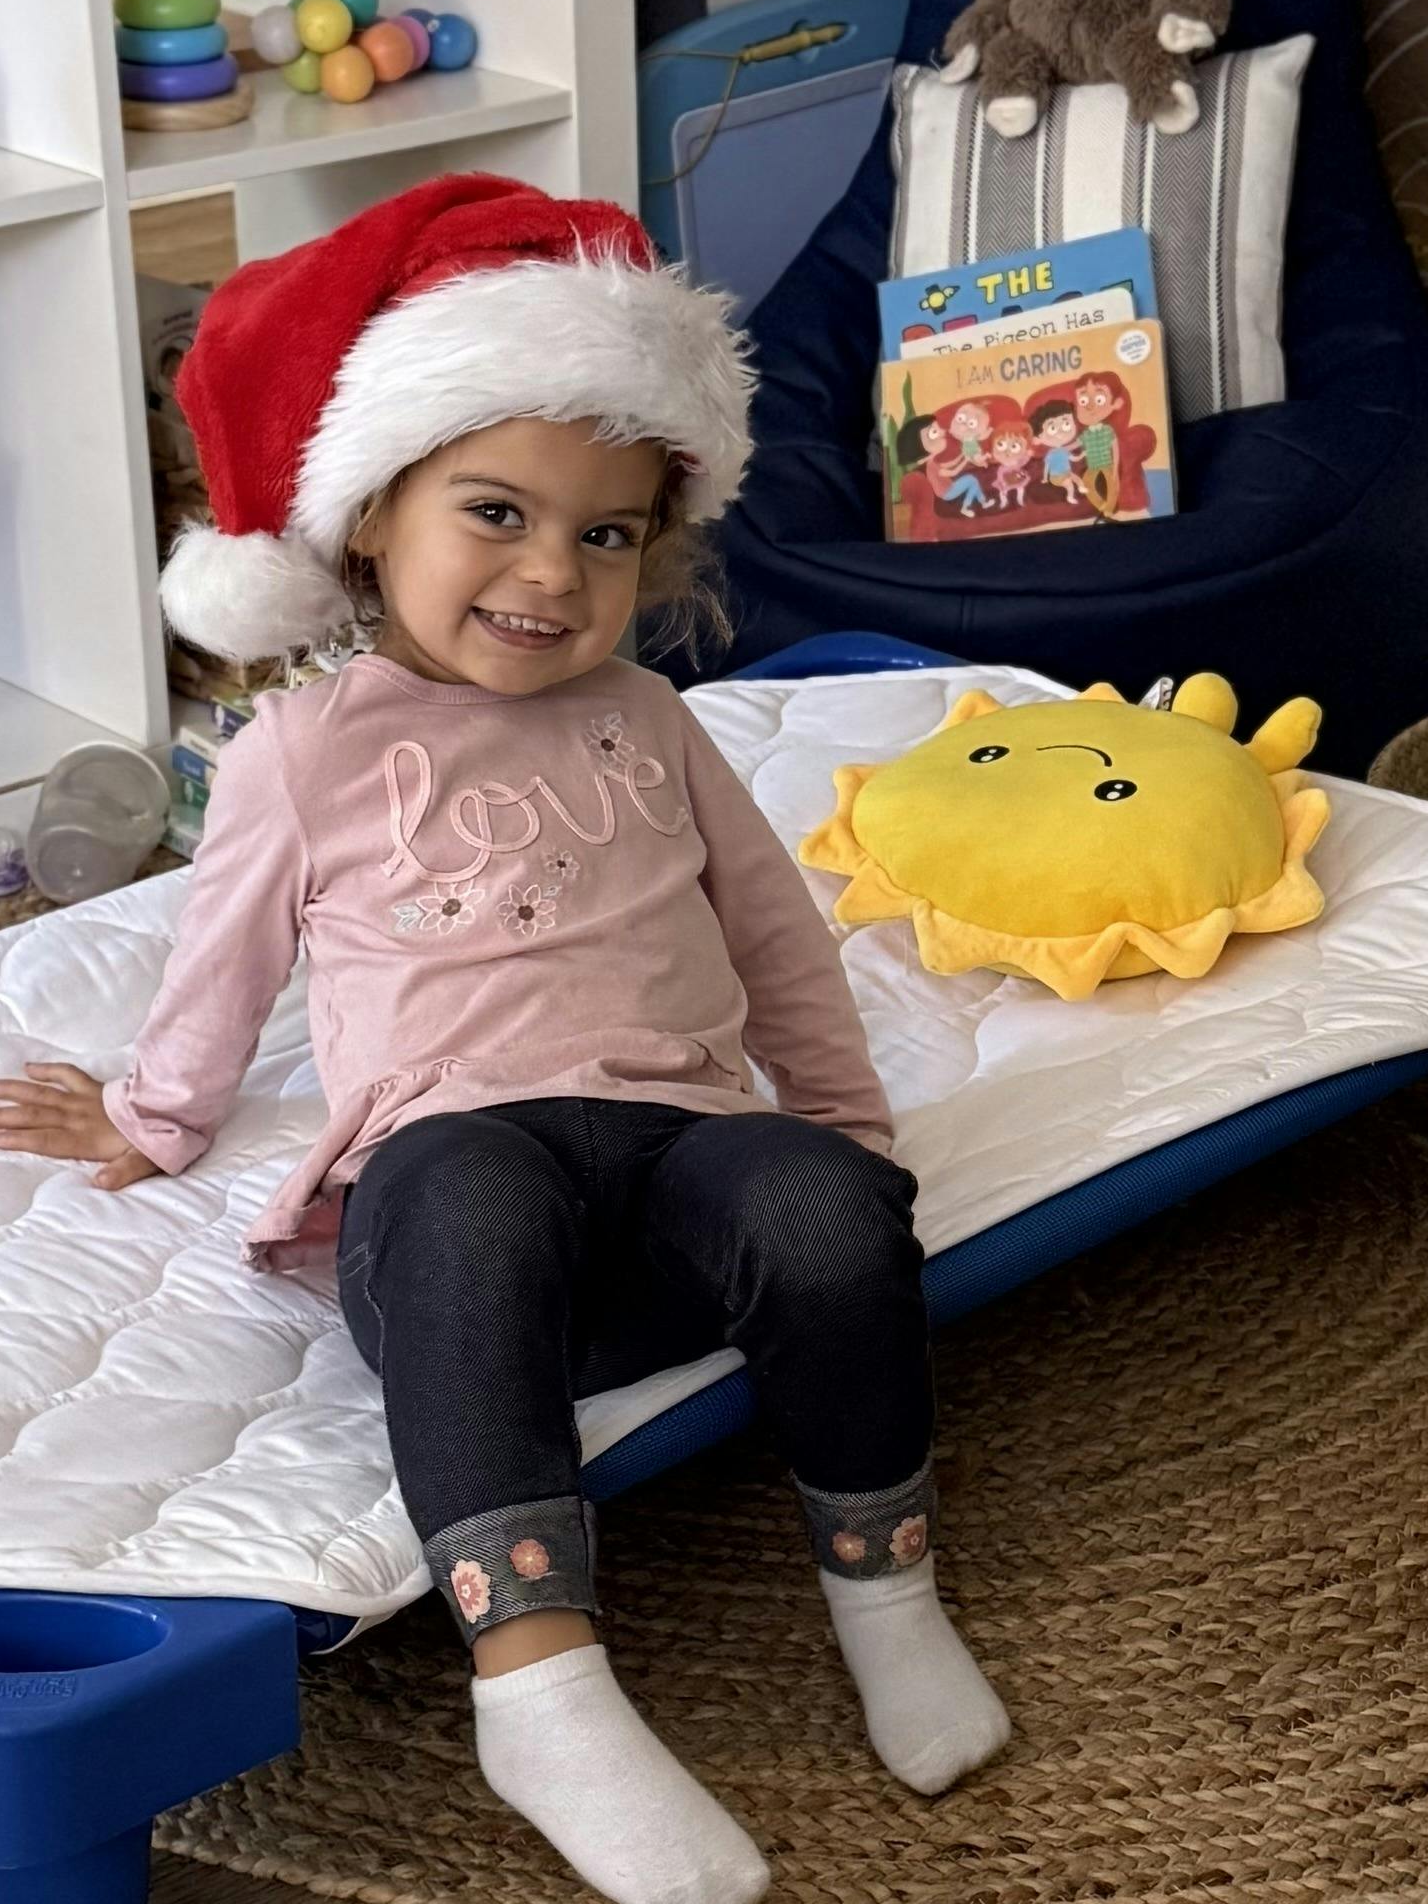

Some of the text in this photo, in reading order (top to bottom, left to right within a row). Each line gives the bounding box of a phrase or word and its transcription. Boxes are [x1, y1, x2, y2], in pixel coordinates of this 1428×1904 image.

[977, 260, 1055, 304] THE
[1065, 308, 1105, 330] Has
[1000, 345, 1083, 382] CARING
[379, 739, 690, 884] love
